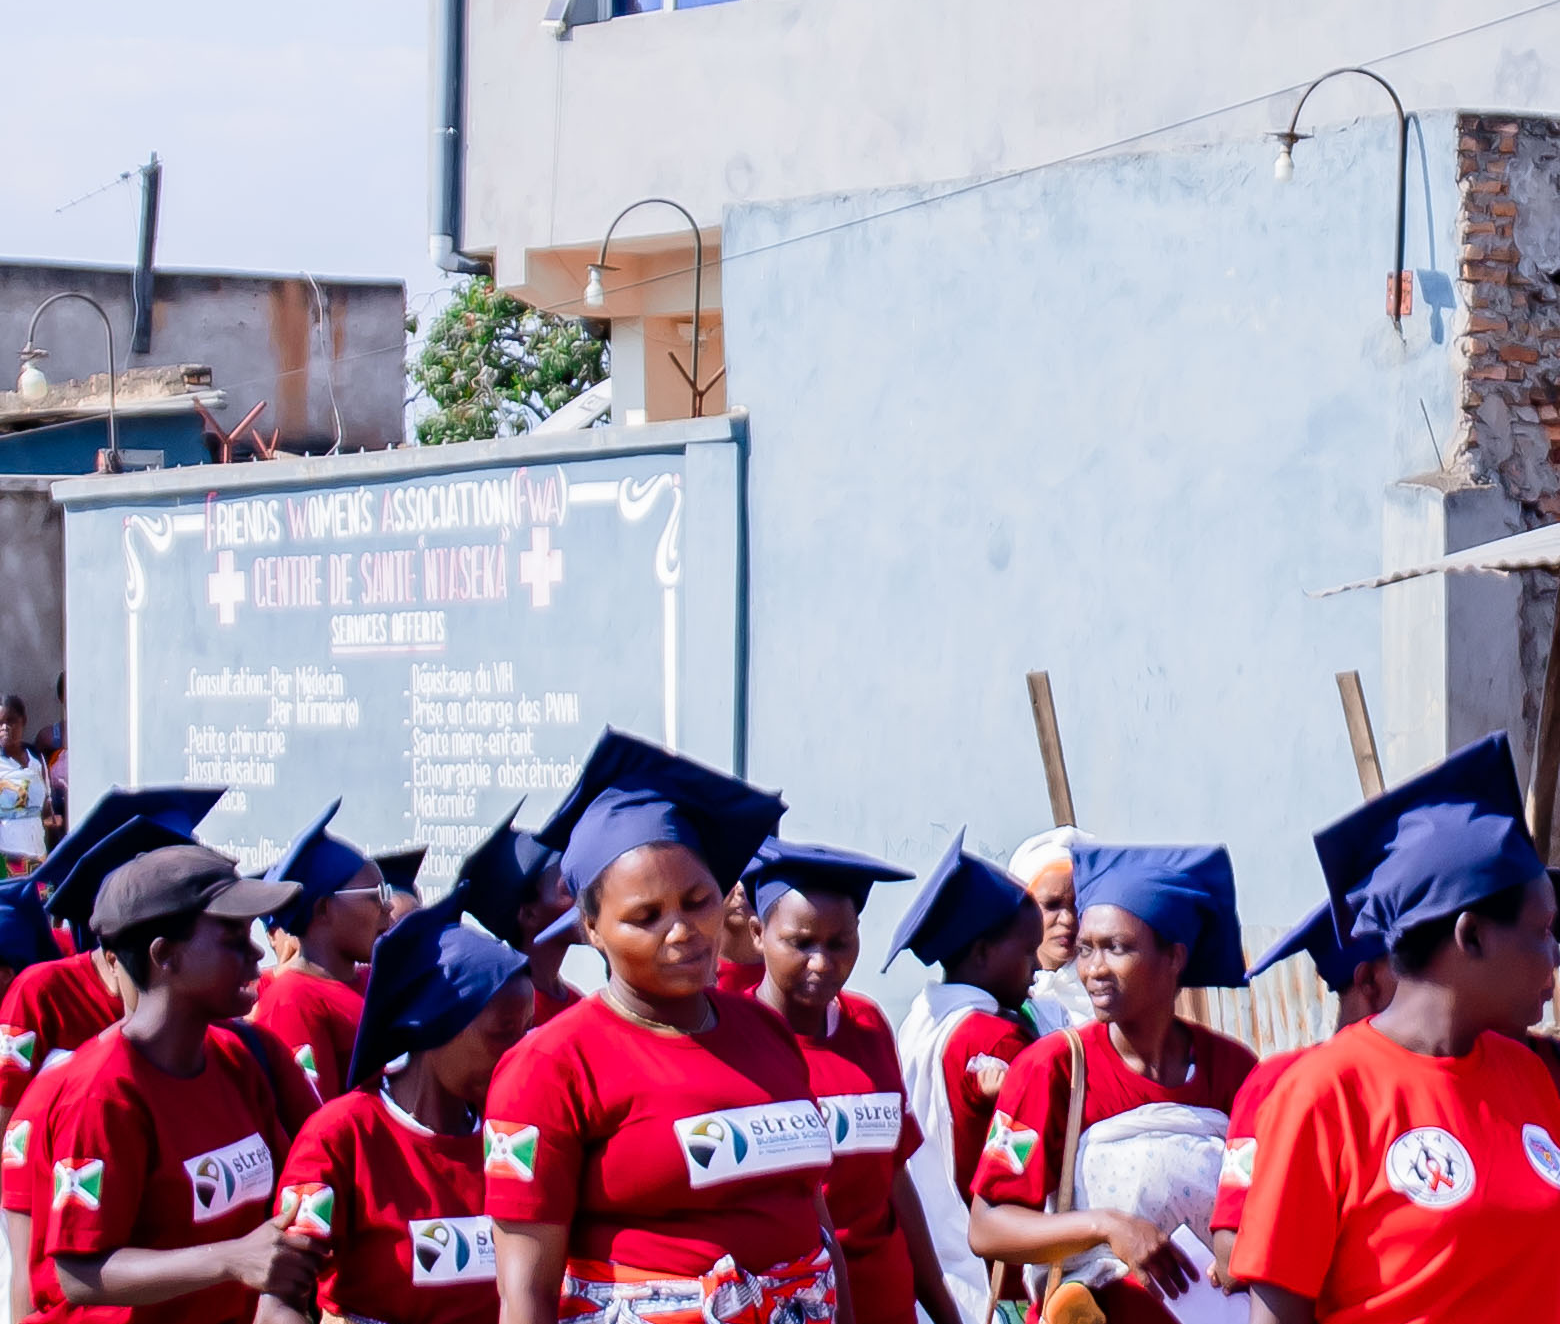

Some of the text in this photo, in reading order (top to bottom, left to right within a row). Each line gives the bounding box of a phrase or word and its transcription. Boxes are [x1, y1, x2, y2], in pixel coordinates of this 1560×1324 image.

[204, 491, 281, 552] FRIENDS
[287, 485, 373, 541] WOMEN'S
[253, 555, 322, 608] CENTRE
[329, 554, 352, 605] DE
[332, 611, 445, 644] SERVICES OFFERTS
[475, 663, 490, 693] du
[494, 662, 514, 692] VIH
[412, 696, 443, 725] Prise
[447, 701, 462, 724] en
[466, 696, 513, 727] charge
[518, 693, 541, 723] des
[229, 725, 285, 758] chirurgie
[412, 725, 449, 757] Santé
[413, 788, 477, 818] Maternité
